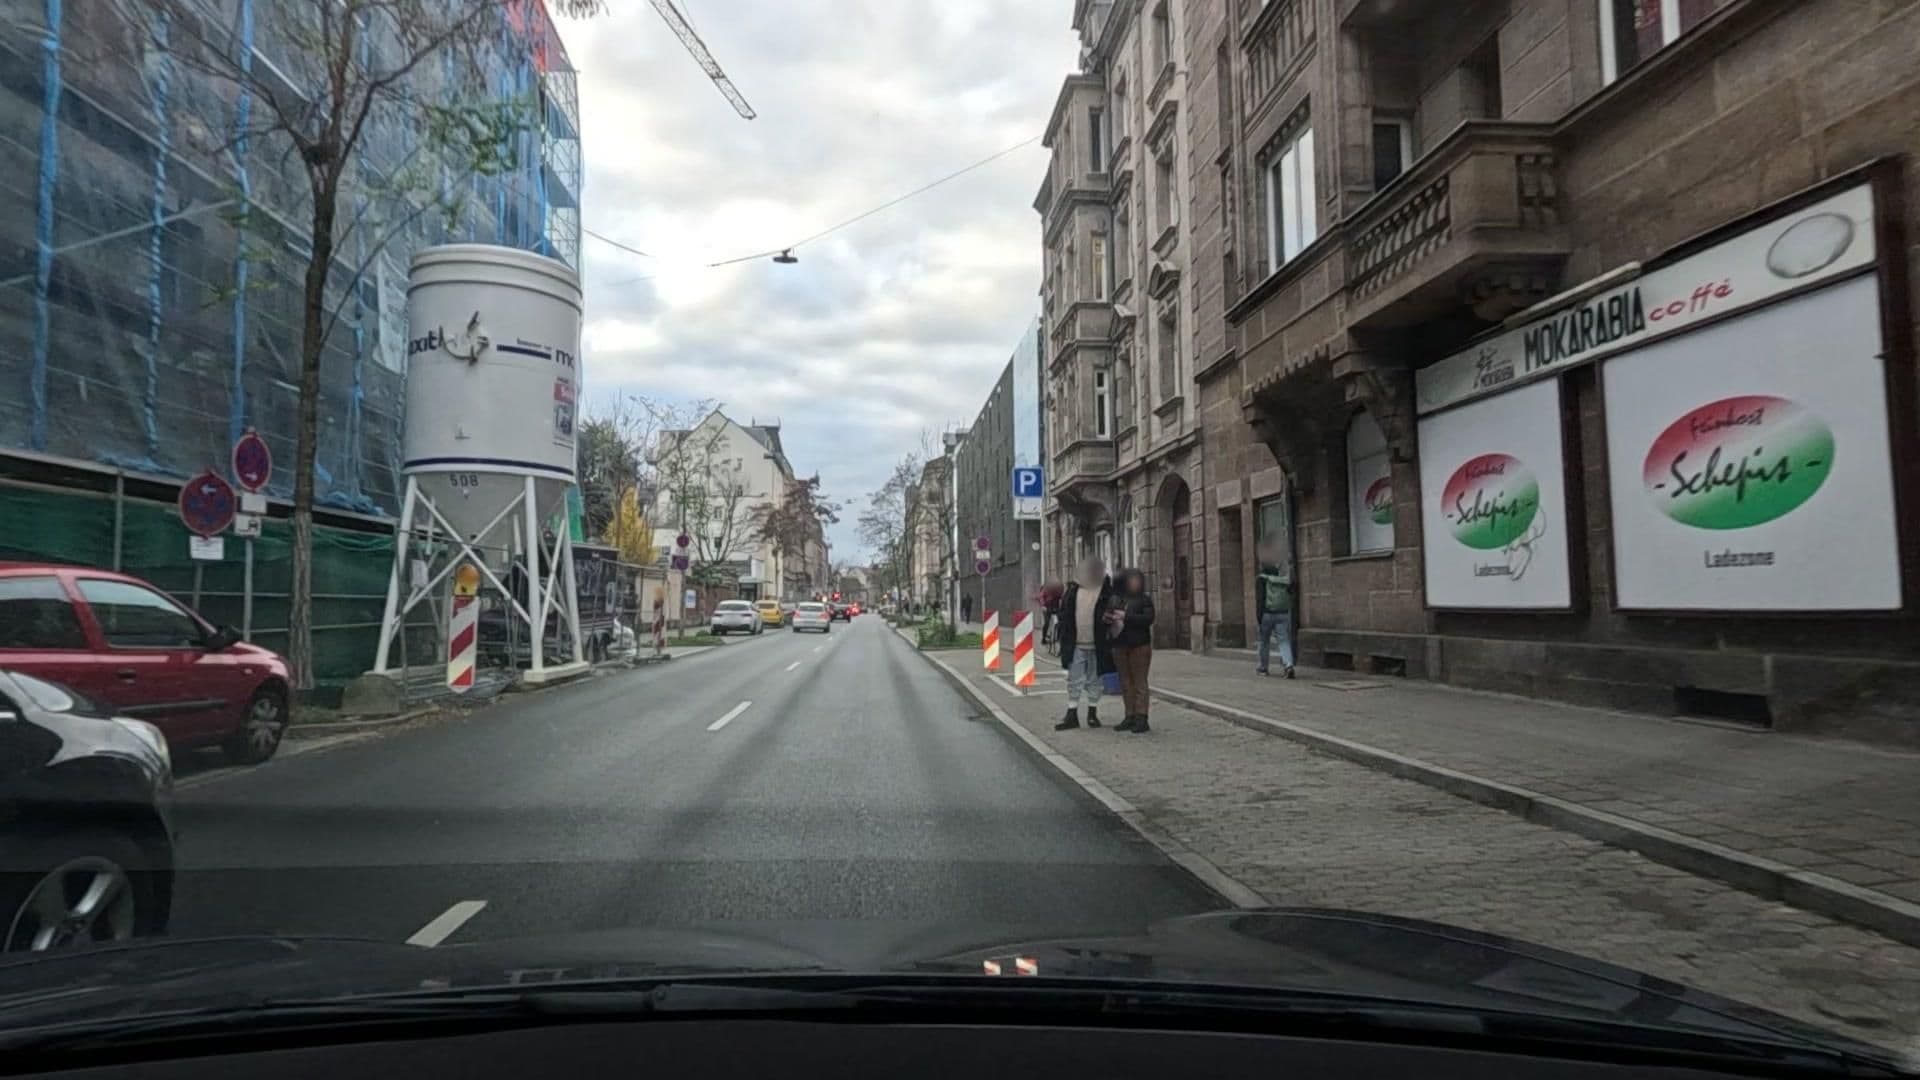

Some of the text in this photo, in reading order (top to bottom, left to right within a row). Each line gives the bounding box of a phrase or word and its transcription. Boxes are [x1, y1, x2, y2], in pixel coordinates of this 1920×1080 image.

[1523, 287, 1646, 372] MOKARABIA
[450, 473, 479, 487] 508
[1020, 470, 1037, 495] P
